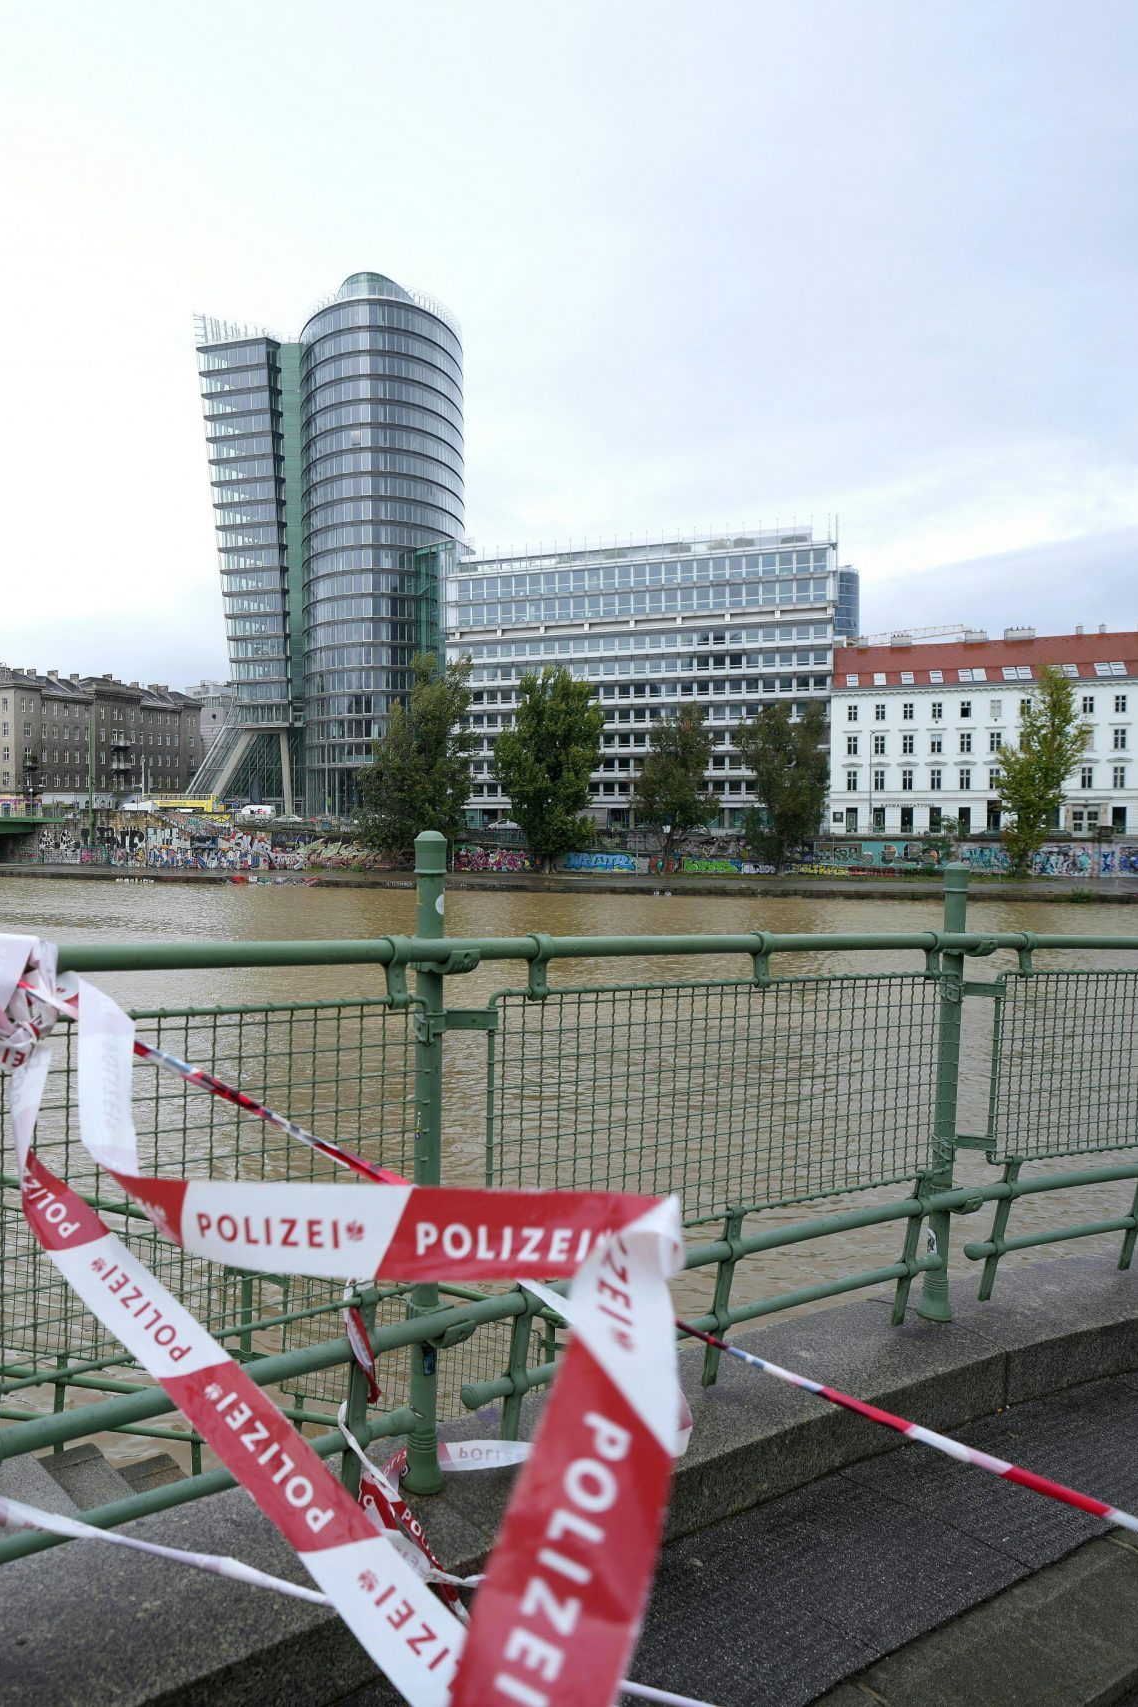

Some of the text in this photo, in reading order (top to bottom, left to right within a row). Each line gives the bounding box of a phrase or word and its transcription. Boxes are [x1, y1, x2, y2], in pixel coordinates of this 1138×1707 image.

[23, 1166, 81, 1238] POLIZ
[197, 1213, 340, 1250] POLIZEI
[416, 1222, 592, 1263] POLIZEI
[100, 1264, 192, 1363] POLIZEI
[216, 1392, 335, 1534] POLIZEI
[494, 1410, 633, 1707] POLIZEI
[374, 1585, 450, 1671] IZEI
